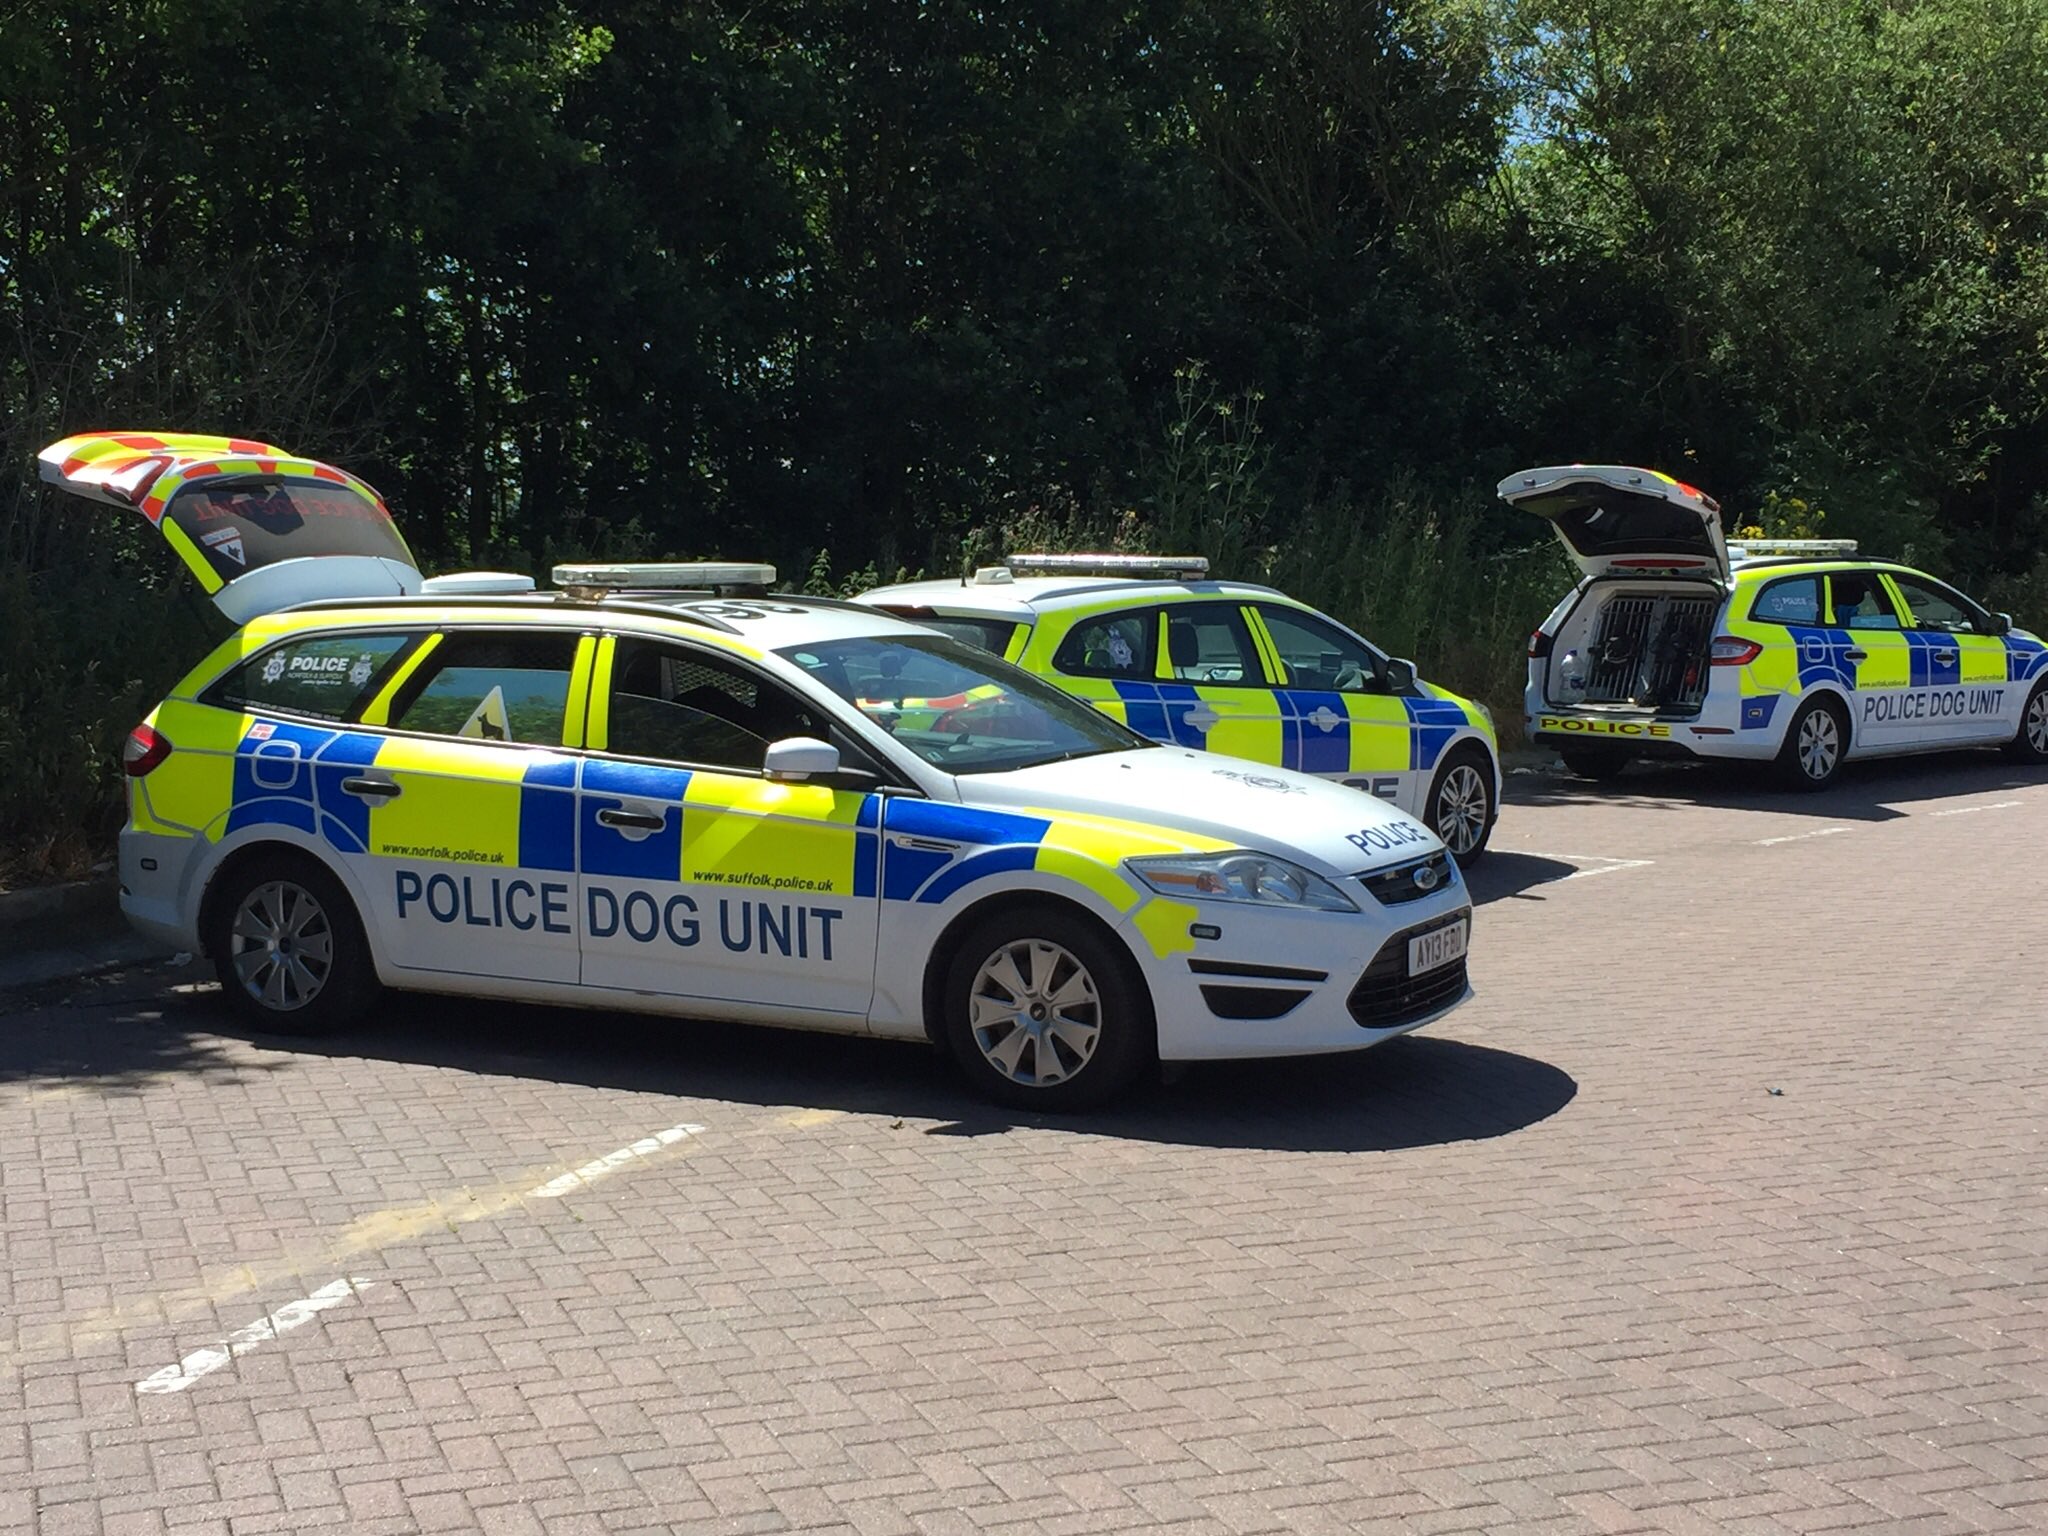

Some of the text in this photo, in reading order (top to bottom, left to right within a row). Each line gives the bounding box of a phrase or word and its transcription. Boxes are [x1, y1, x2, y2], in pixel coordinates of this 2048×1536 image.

[289, 657, 349, 672] POLICE
[1863, 689, 2004, 722] POLICE DOG UNIT
[1541, 718, 1669, 737] POLICE
[1345, 821, 1428, 856] POLICE
[382, 843, 504, 864] www.norfolk.police.uk
[693, 870, 833, 892] www.suffolk.police.uk
[396, 869, 843, 961] POLICE DOG UNIT
